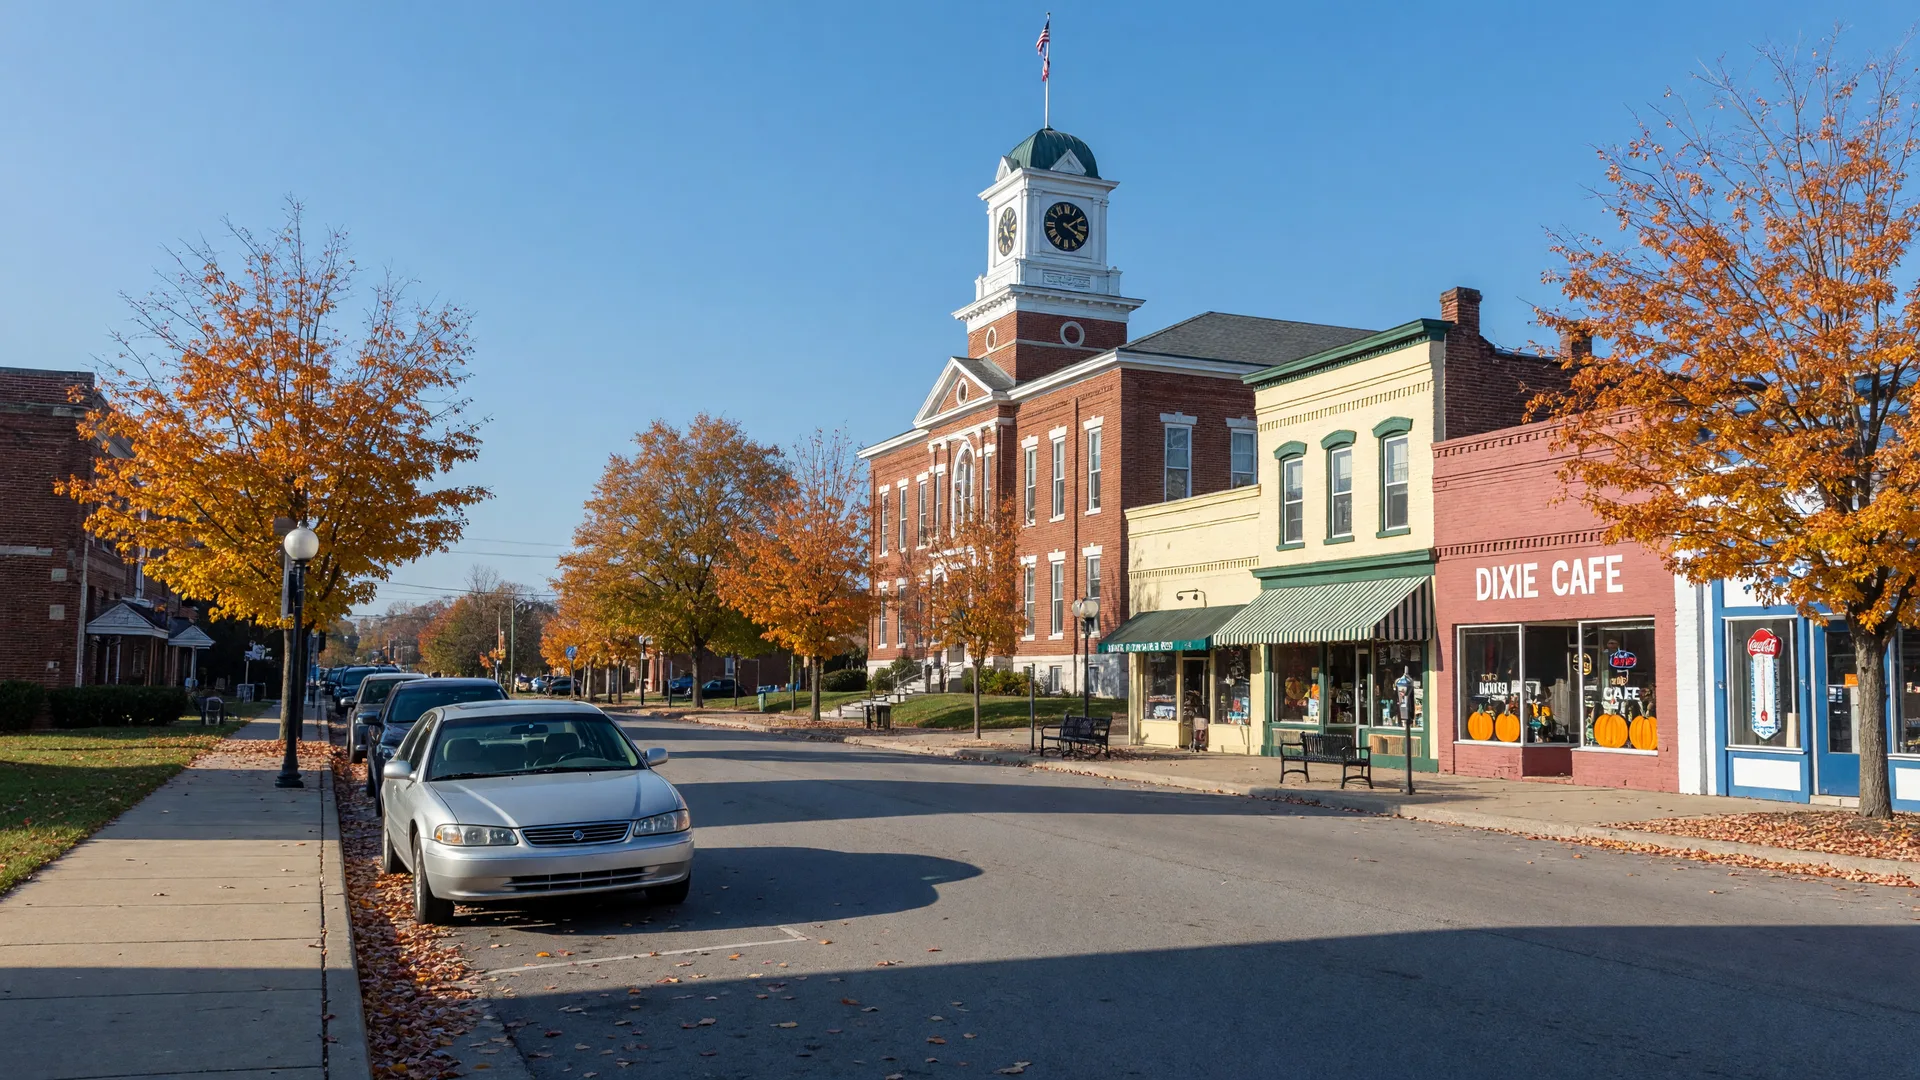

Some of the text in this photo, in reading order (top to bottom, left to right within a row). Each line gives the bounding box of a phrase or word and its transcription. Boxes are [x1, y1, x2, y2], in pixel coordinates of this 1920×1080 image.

[1476, 554, 1623, 601] DIXIE CAFE
[1603, 687, 1641, 700] CAFE
